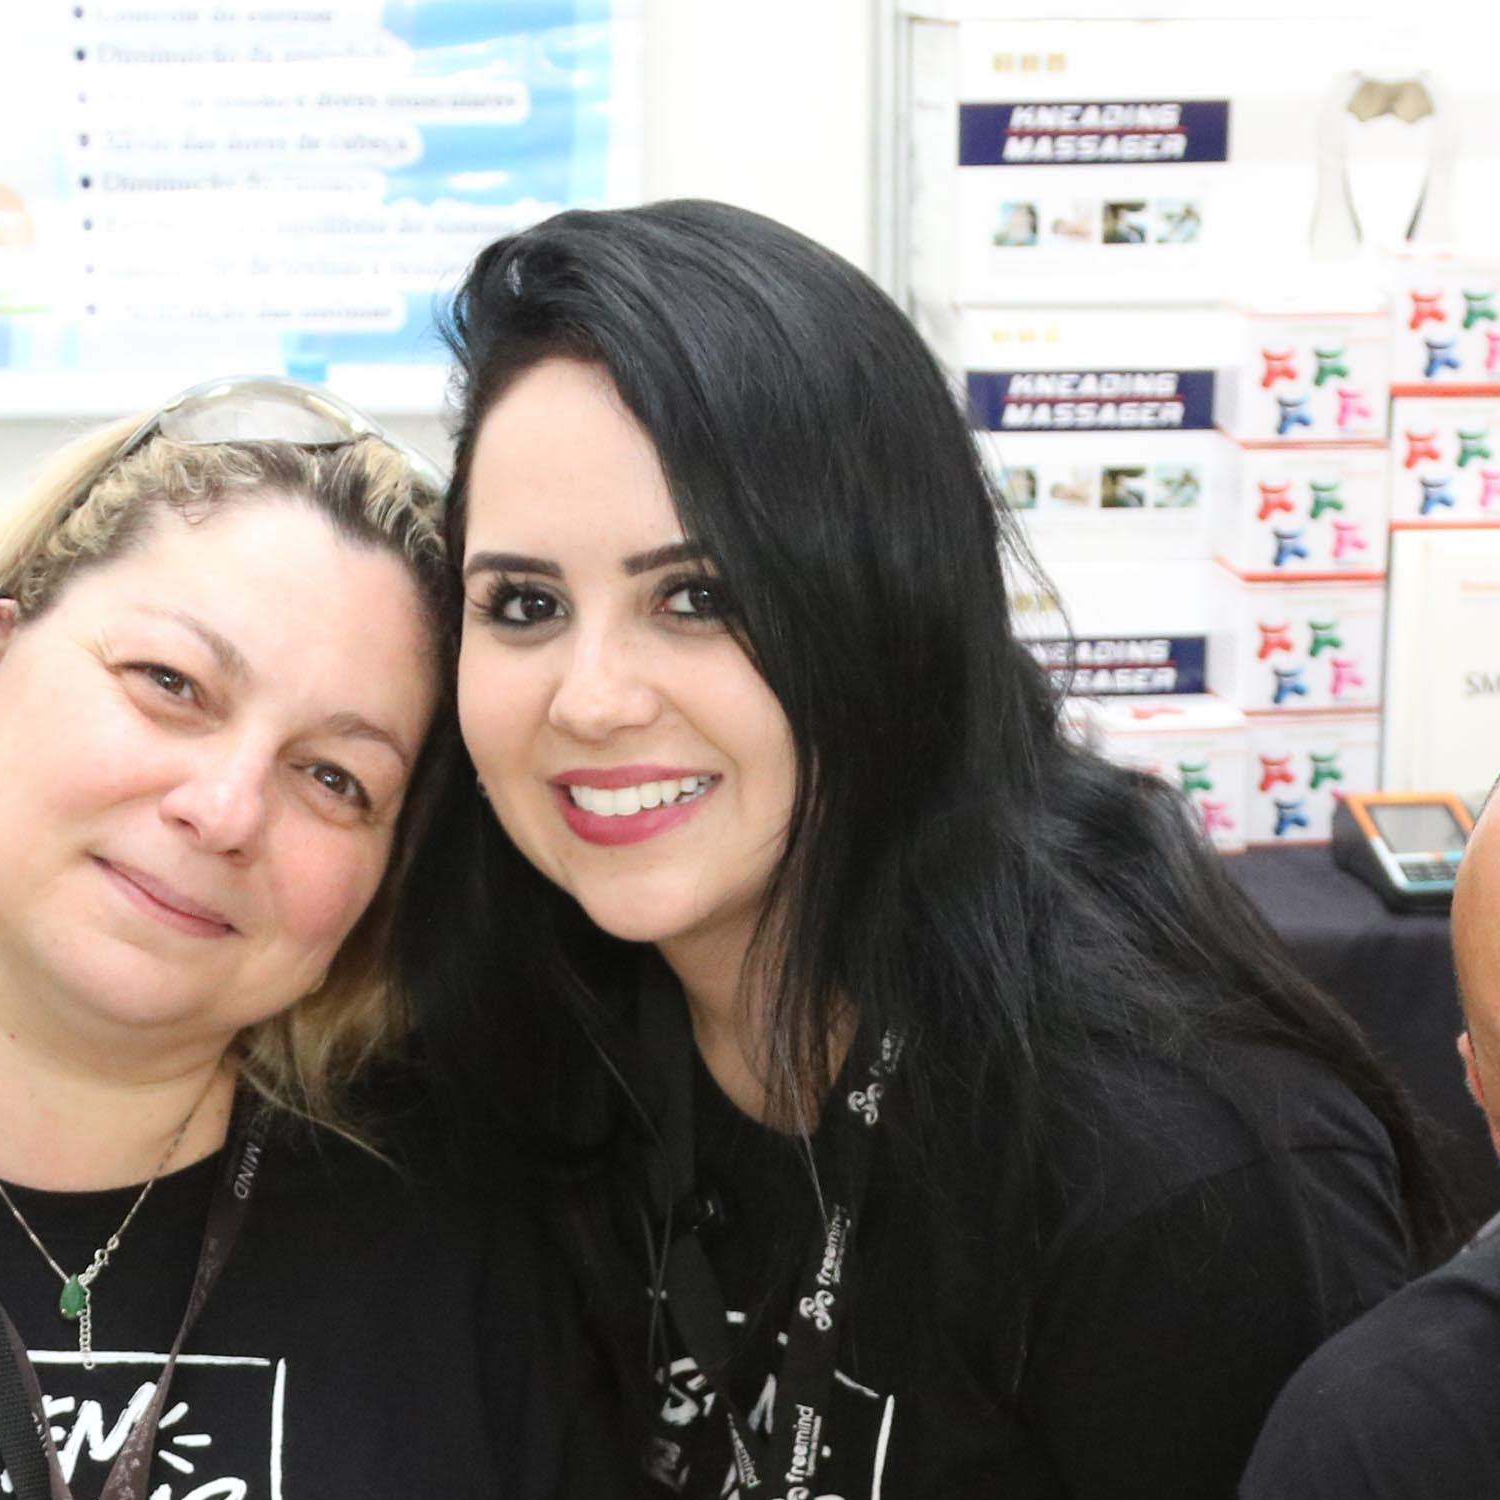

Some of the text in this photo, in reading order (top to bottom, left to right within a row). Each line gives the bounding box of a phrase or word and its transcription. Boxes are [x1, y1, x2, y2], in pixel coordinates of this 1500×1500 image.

[1009, 104, 1182, 129] KNEADING
[1002, 133, 1187, 162] MASSAGER
[1008, 373, 1178, 398] KNEADING
[1001, 401, 1185, 429] MASSAGER
[1027, 640, 1171, 662] NEADING
[785, 1404, 815, 1483] freemind
